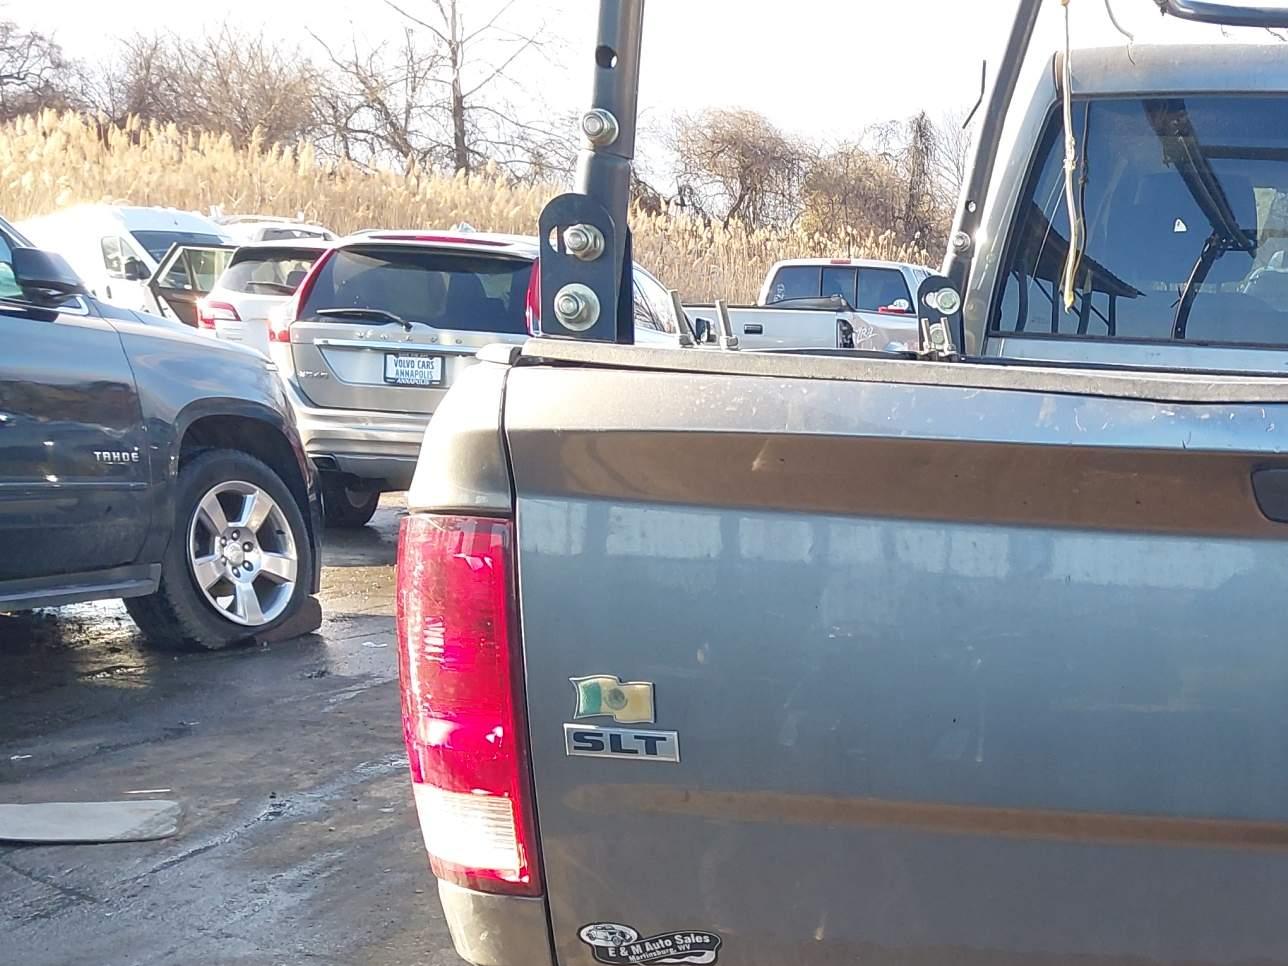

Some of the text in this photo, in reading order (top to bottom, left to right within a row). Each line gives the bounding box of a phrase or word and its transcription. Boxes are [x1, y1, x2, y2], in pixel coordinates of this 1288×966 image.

[393, 359, 435, 370] VOLVO CARS
[395, 369, 434, 379] ANNAPOLIS
[93, 451, 140, 462] TAHOE
[572, 731, 668, 756] SLT
[608, 933, 711, 957] E & M Auto Sales
[677, 943, 692, 952] WV
